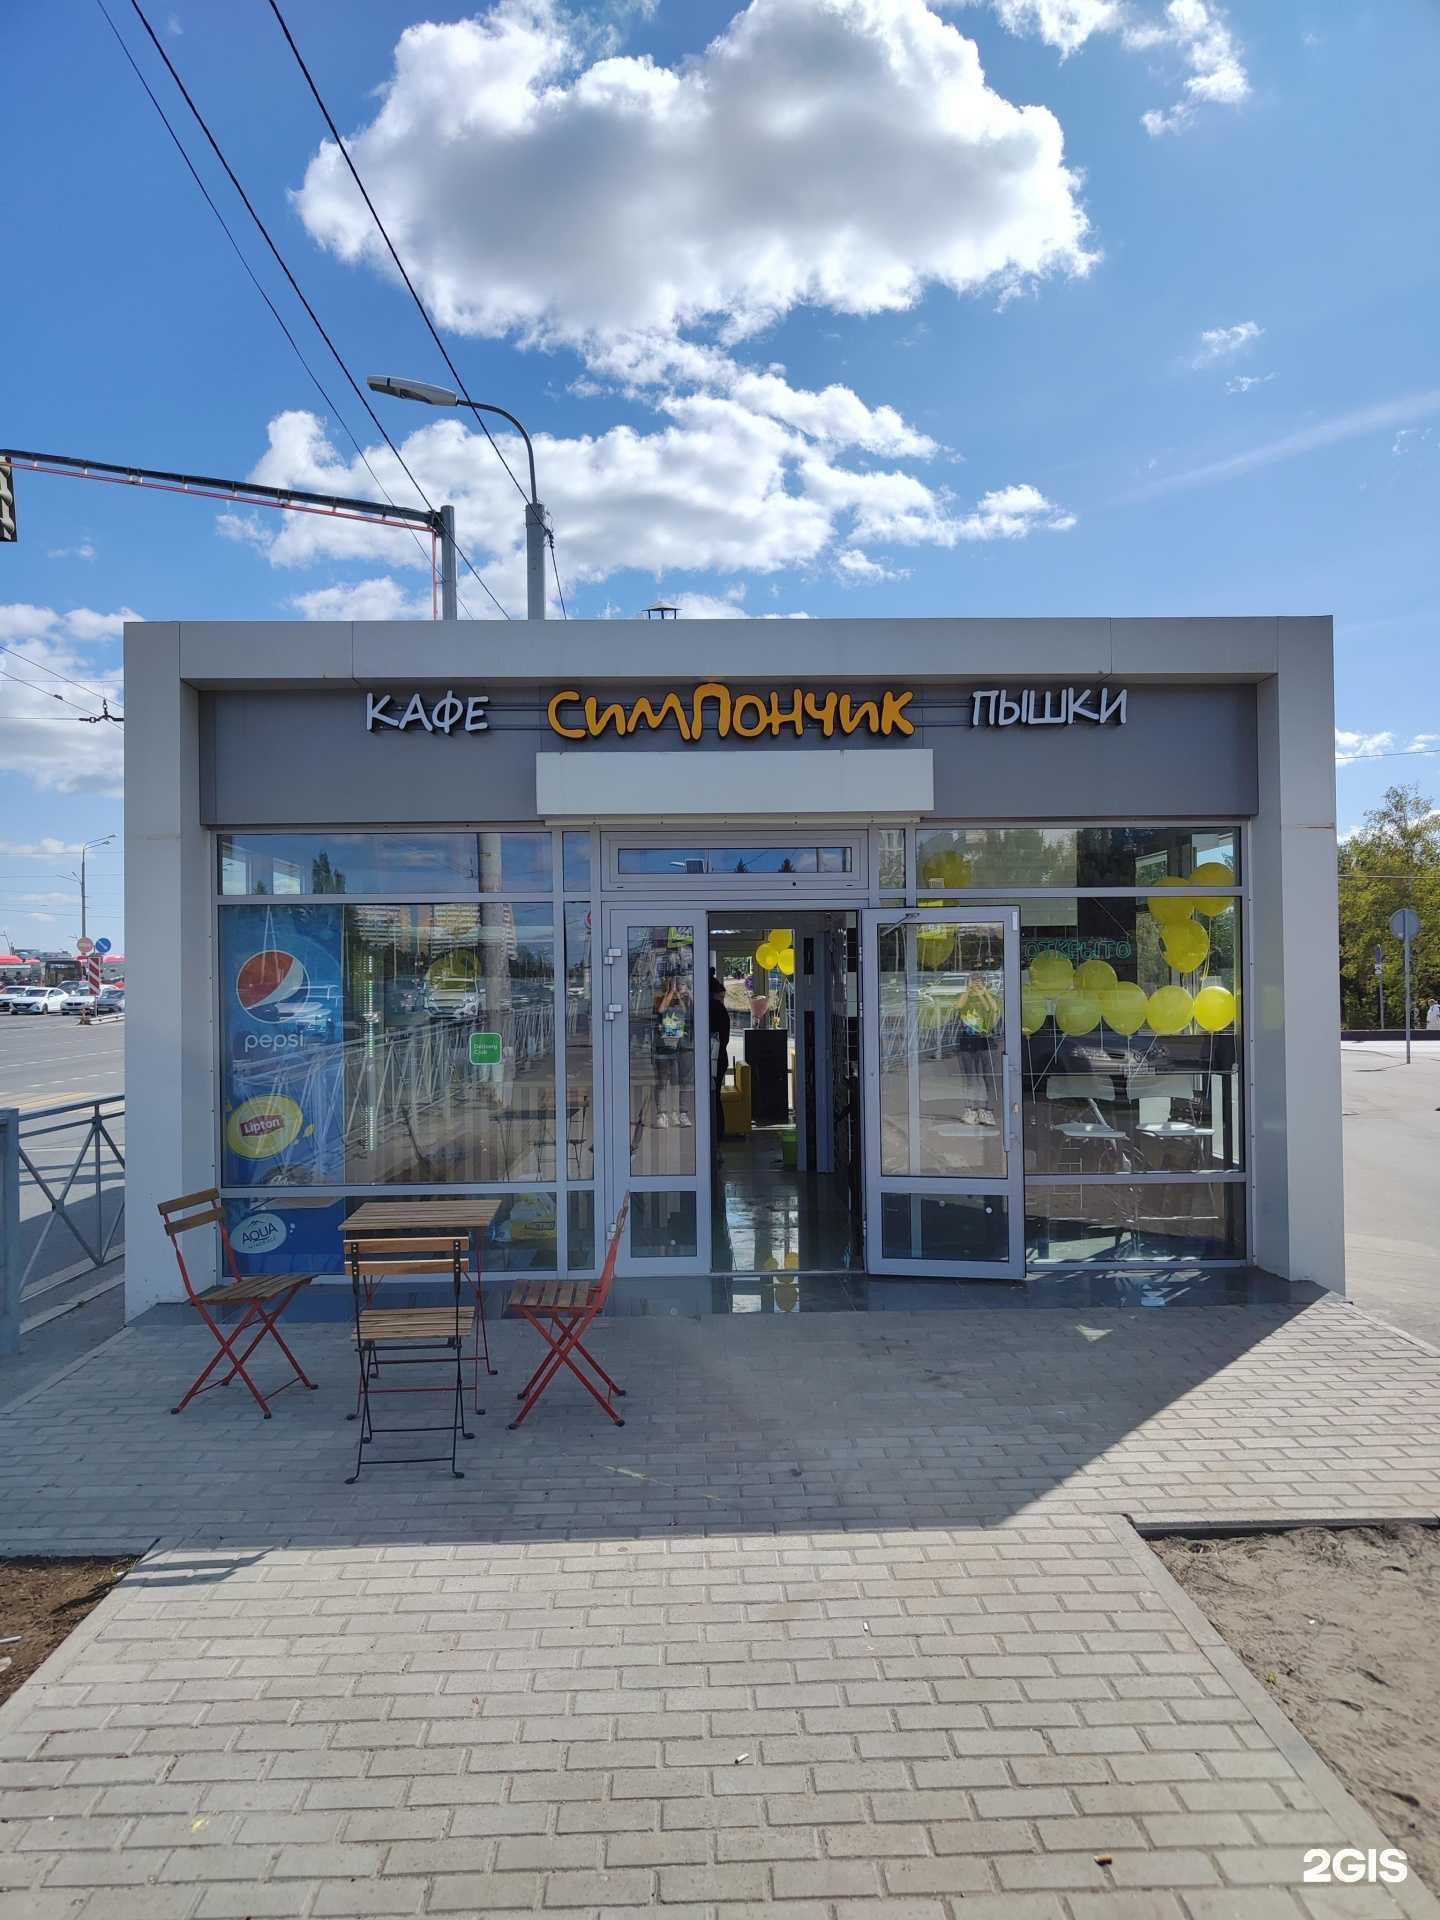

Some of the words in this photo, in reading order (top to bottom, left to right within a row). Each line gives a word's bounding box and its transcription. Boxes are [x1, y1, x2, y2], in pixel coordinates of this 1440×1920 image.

[366, 690, 489, 734] КАФЕ
[972, 687, 1128, 726] ПЫШКИ
[244, 1030, 304, 1053] pepsi
[243, 1117, 280, 1135] Lipton
[241, 1223, 278, 1244] AQUA
